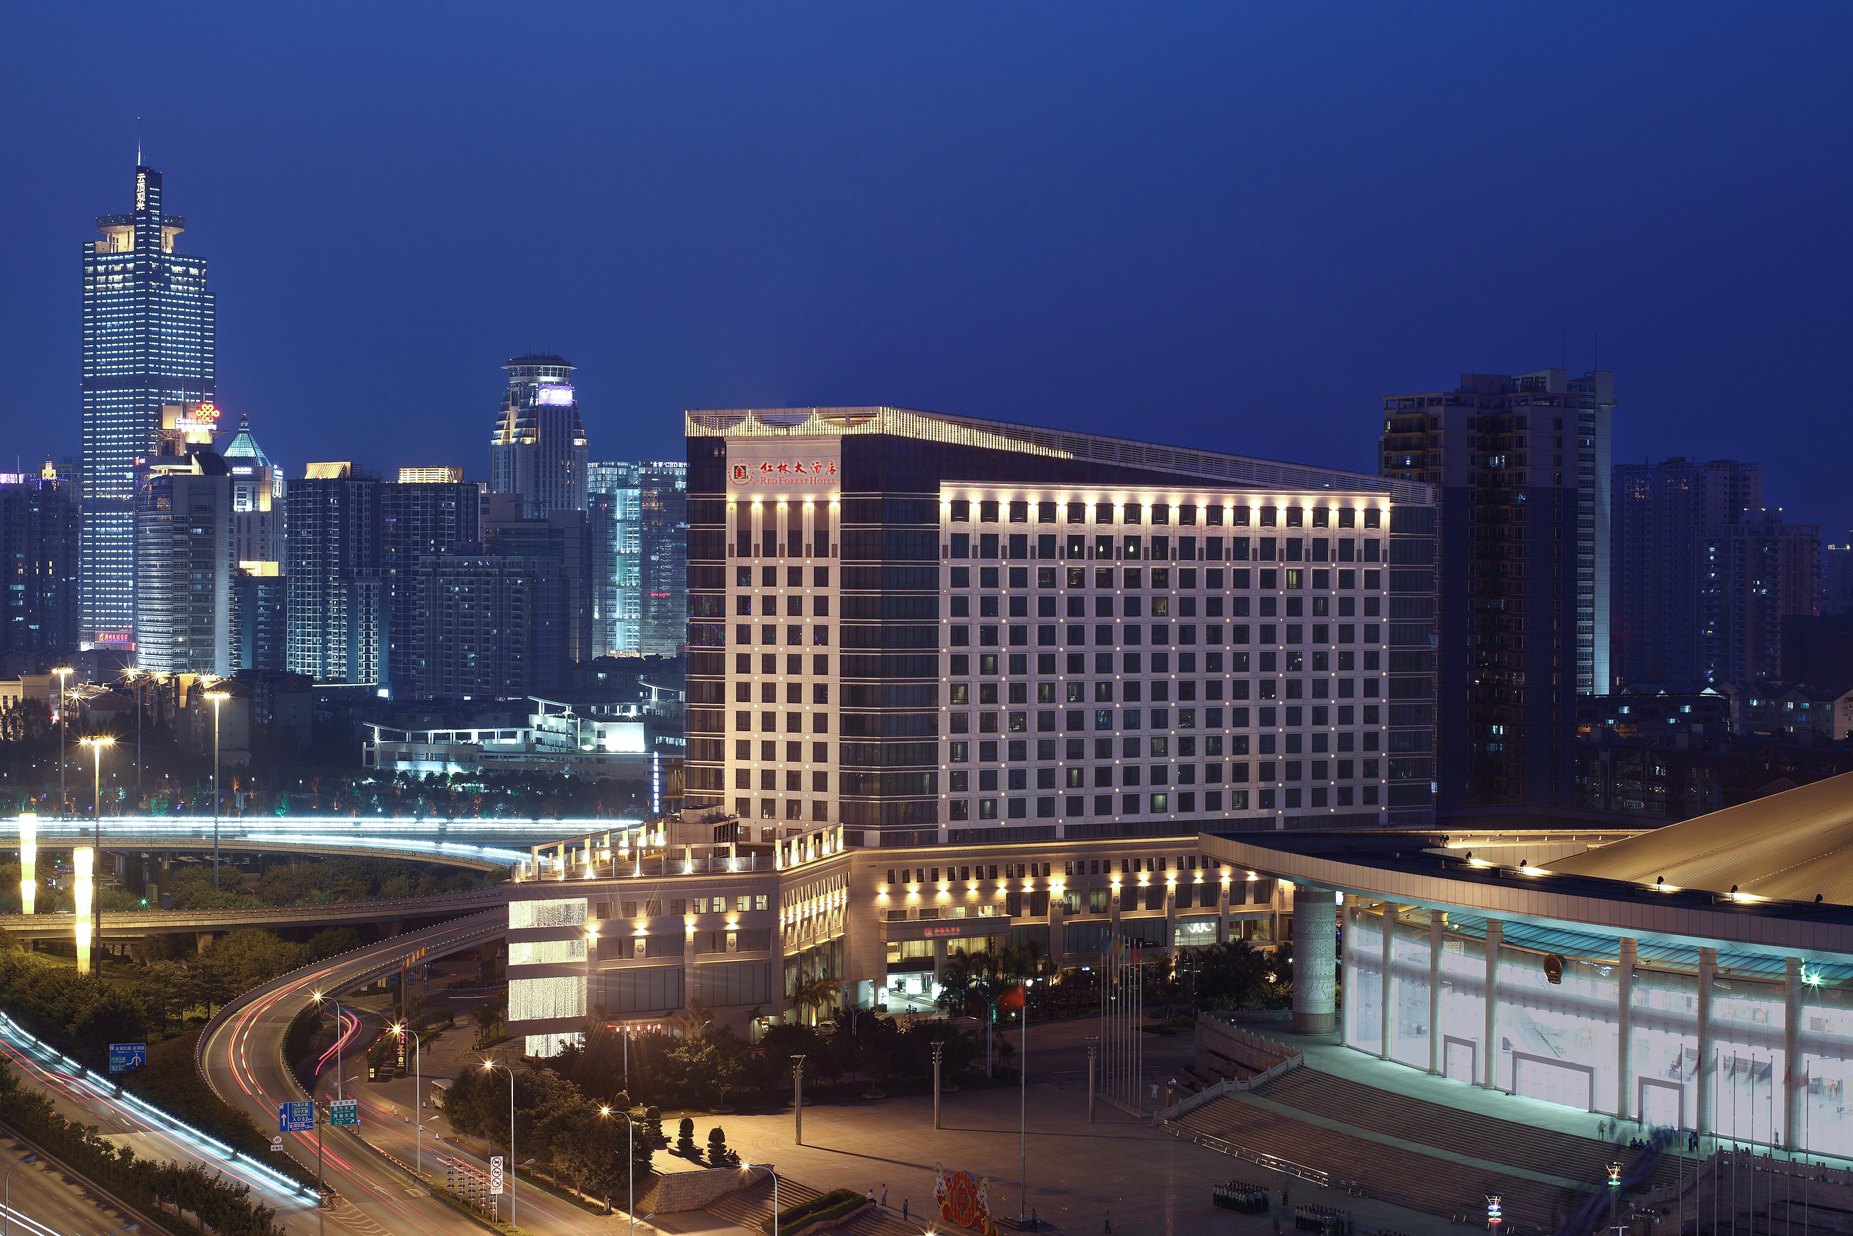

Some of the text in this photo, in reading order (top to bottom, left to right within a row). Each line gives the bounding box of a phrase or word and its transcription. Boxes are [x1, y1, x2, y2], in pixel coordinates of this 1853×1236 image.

[760, 460, 837, 475] 红林大酒店
[760, 476, 777, 485] RED
[779, 476, 809, 485] FOREST
[810, 476, 837, 485] HOTEL
